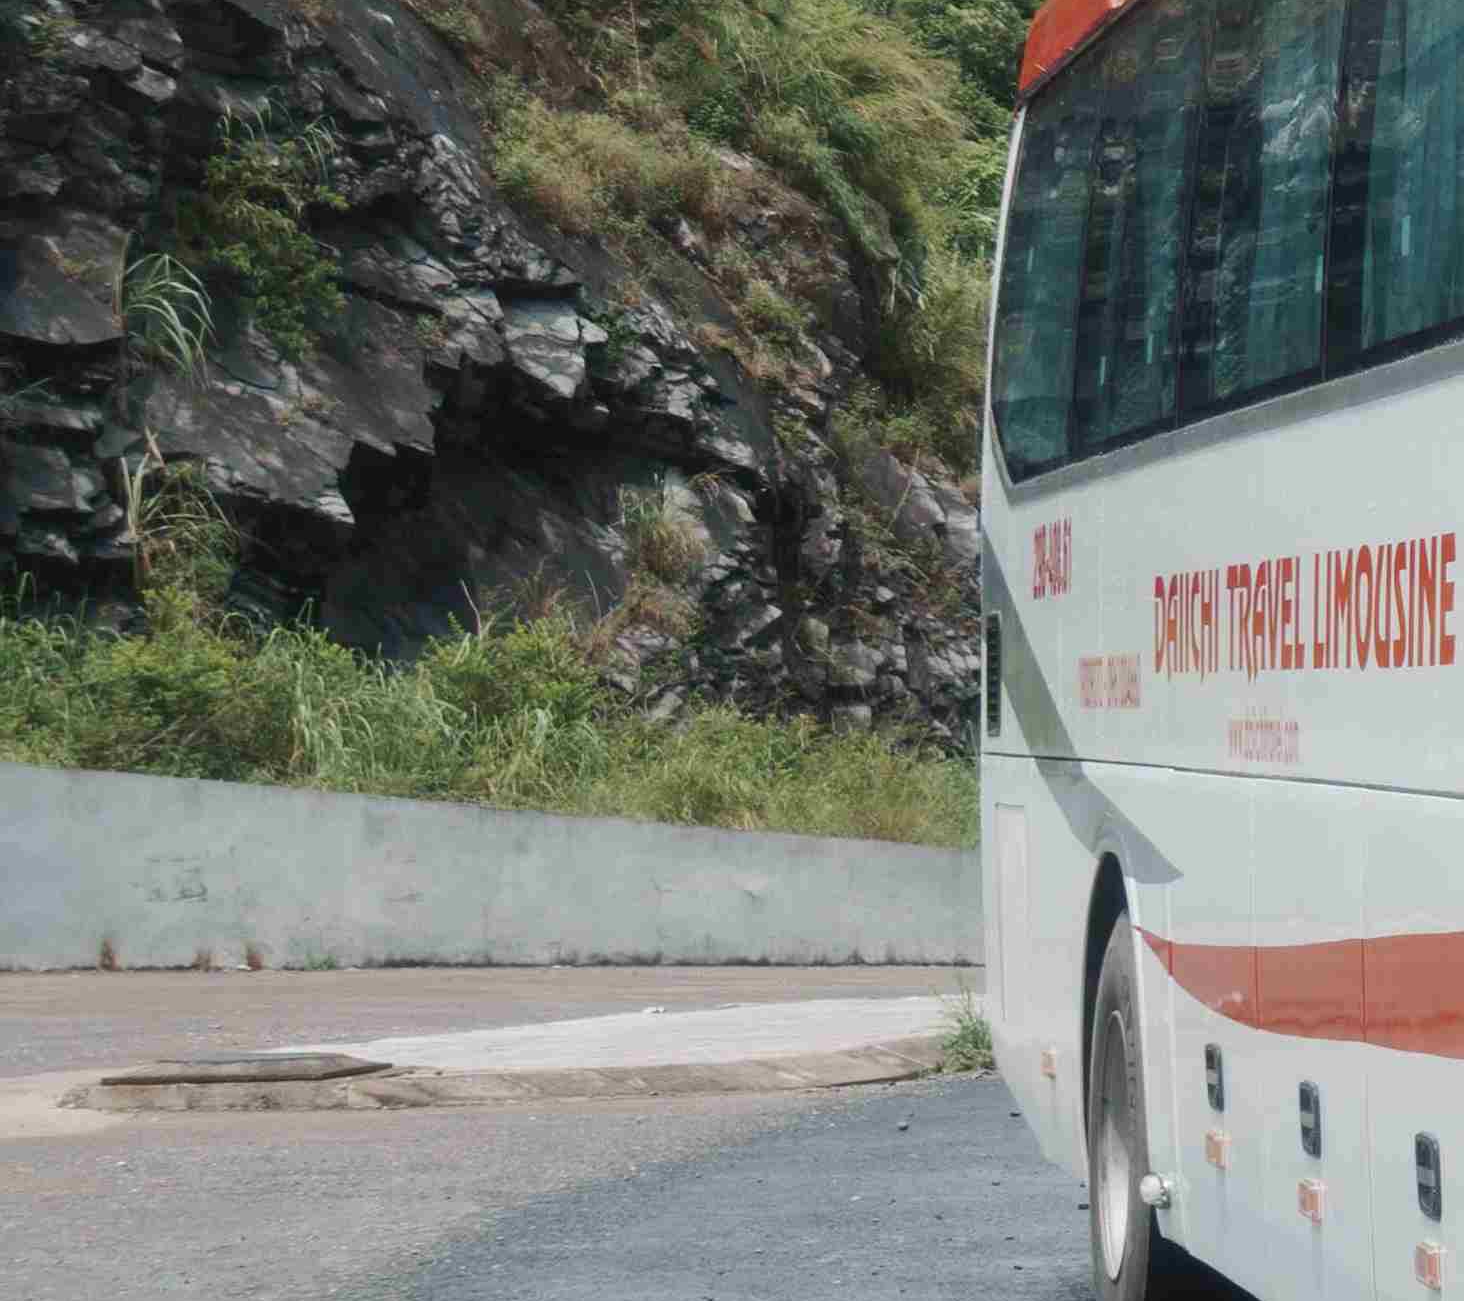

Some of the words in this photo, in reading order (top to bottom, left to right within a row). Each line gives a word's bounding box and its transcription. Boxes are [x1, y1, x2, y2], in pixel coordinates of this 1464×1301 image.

[1154, 569, 1219, 685] DAIICHI
[1227, 556, 1304, 685] TRAVEL
[1313, 532, 1456, 671] LIMOUSINE
